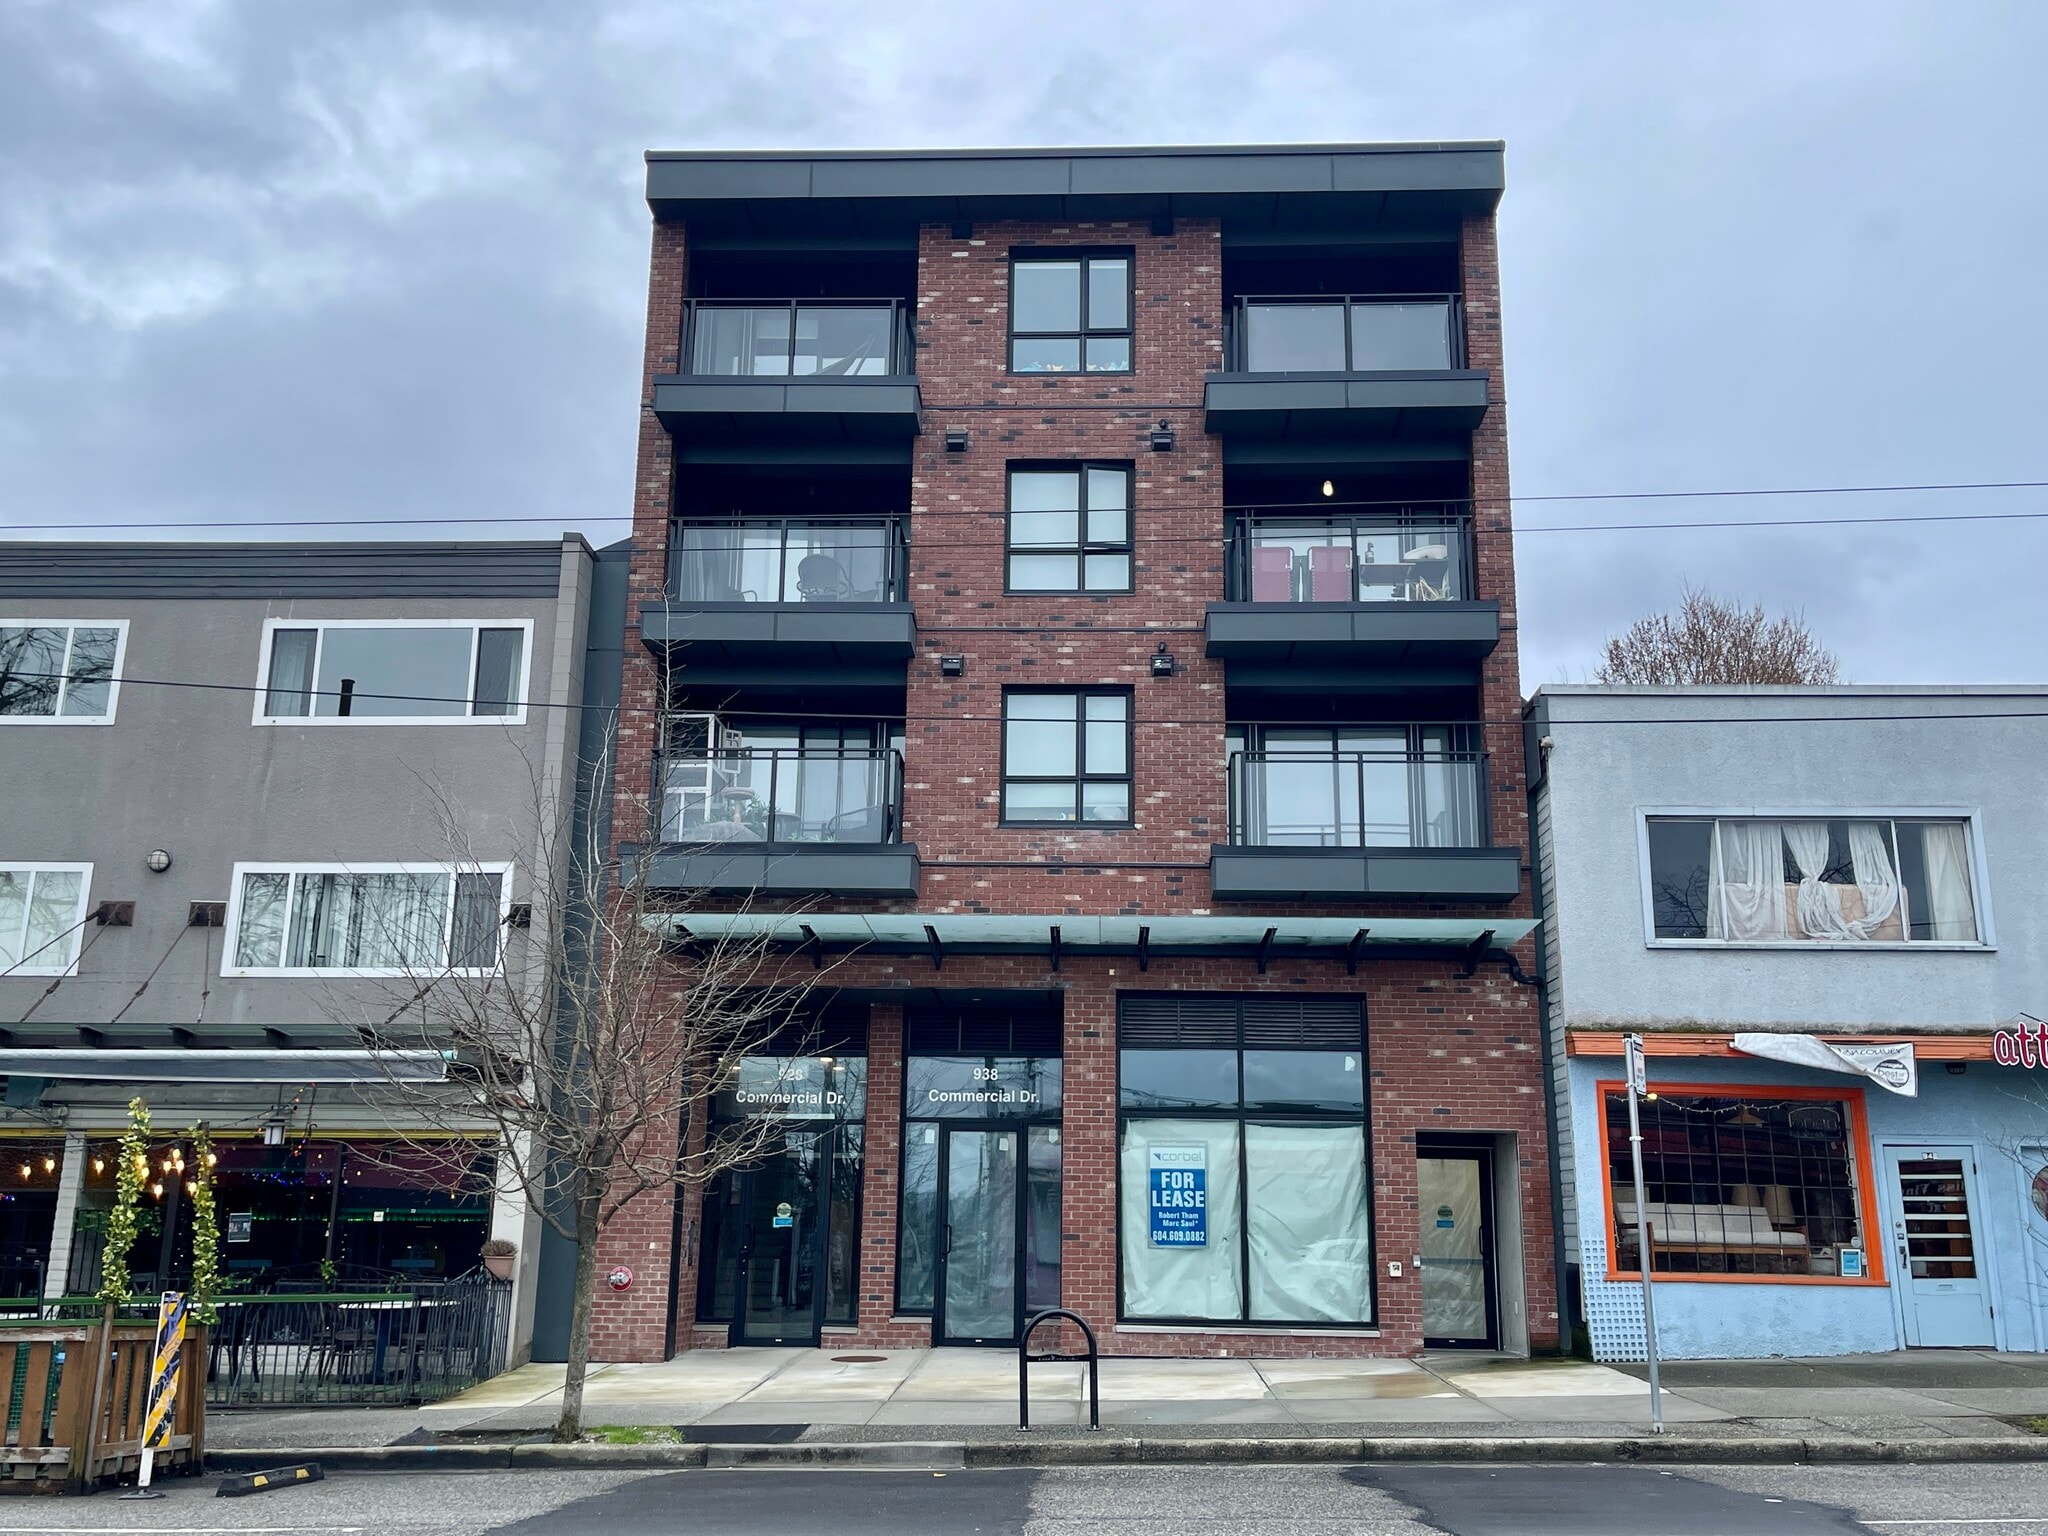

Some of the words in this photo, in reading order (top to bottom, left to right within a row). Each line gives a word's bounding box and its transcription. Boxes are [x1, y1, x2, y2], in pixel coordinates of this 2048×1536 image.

[1994, 1022, 2048, 1069] att
[973, 1068, 999, 1081] 938
[736, 1090, 822, 1104] Commercial
[827, 1092, 847, 1105] Dr.
[928, 1089, 1016, 1103] Commercial
[1020, 1090, 1040, 1103] Dr.
[1162, 1151, 1203, 1162] corbel
[1161, 1172, 1195, 1189] FOR
[1152, 1190, 1205, 1207] LEASE
